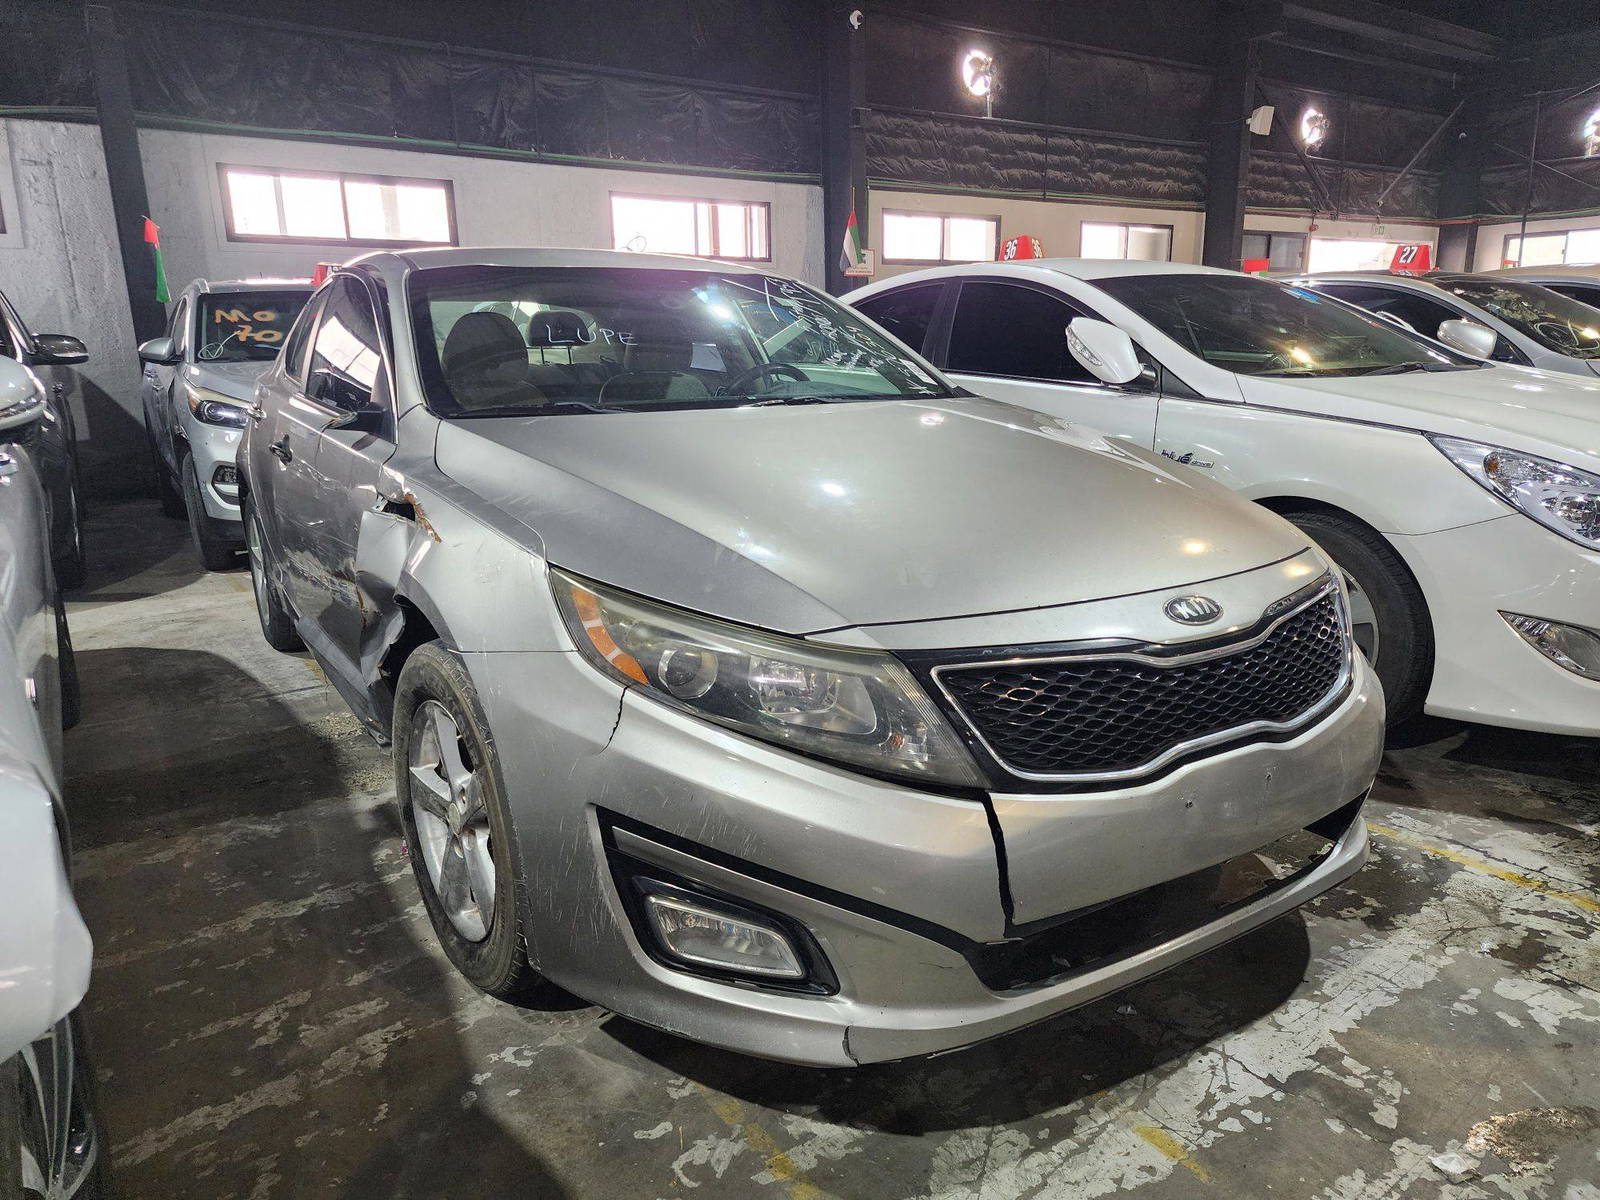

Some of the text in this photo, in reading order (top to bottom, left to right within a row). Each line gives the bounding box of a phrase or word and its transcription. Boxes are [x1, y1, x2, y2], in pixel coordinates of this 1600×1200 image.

[1004, 239, 1018, 260] 36
[1399, 246, 1418, 264] 27
[233, 325, 282, 342] 70
[545, 323, 638, 346] LUPE
[1173, 598, 1218, 619] KIA
